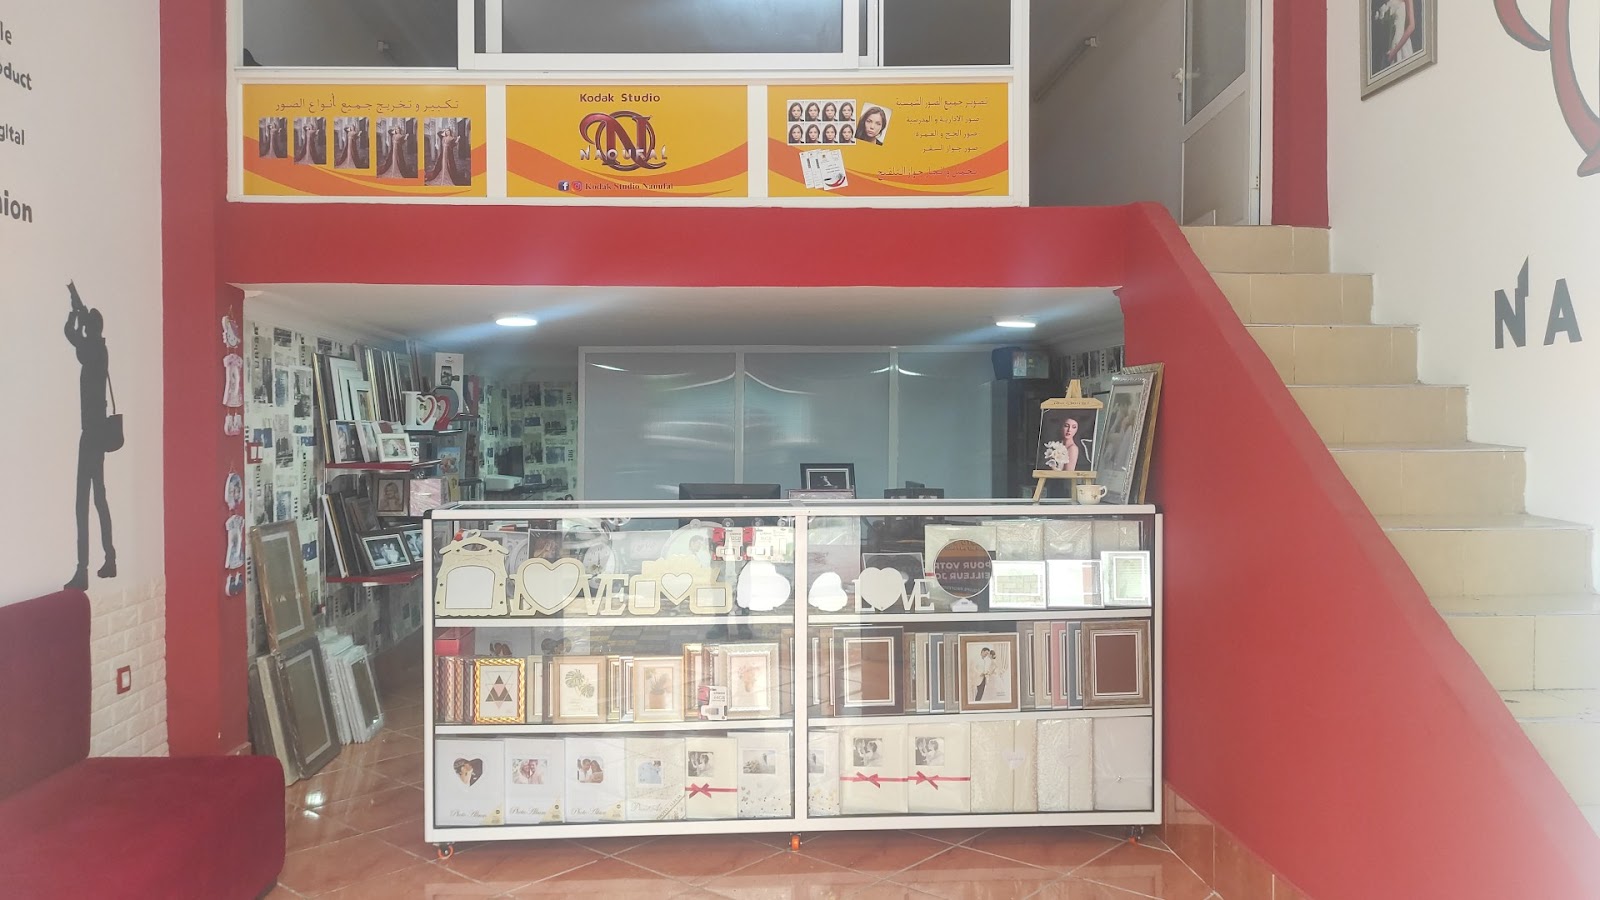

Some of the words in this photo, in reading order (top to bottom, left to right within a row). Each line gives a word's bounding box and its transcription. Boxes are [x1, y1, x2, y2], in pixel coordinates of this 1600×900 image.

[308, 92, 336, 114] أنواع
[579, 92, 615, 103] Kodak
[621, 92, 661, 103] Studio
[275, 98, 305, 112] الصور
[341, 102, 373, 114] جميع
[376, 100, 412, 114] تخريج
[415, 103, 420, 112] و
[423, 99, 459, 112] تكبير
[585, 182, 612, 191] Kodak
[614, 182, 640, 191] Studio
